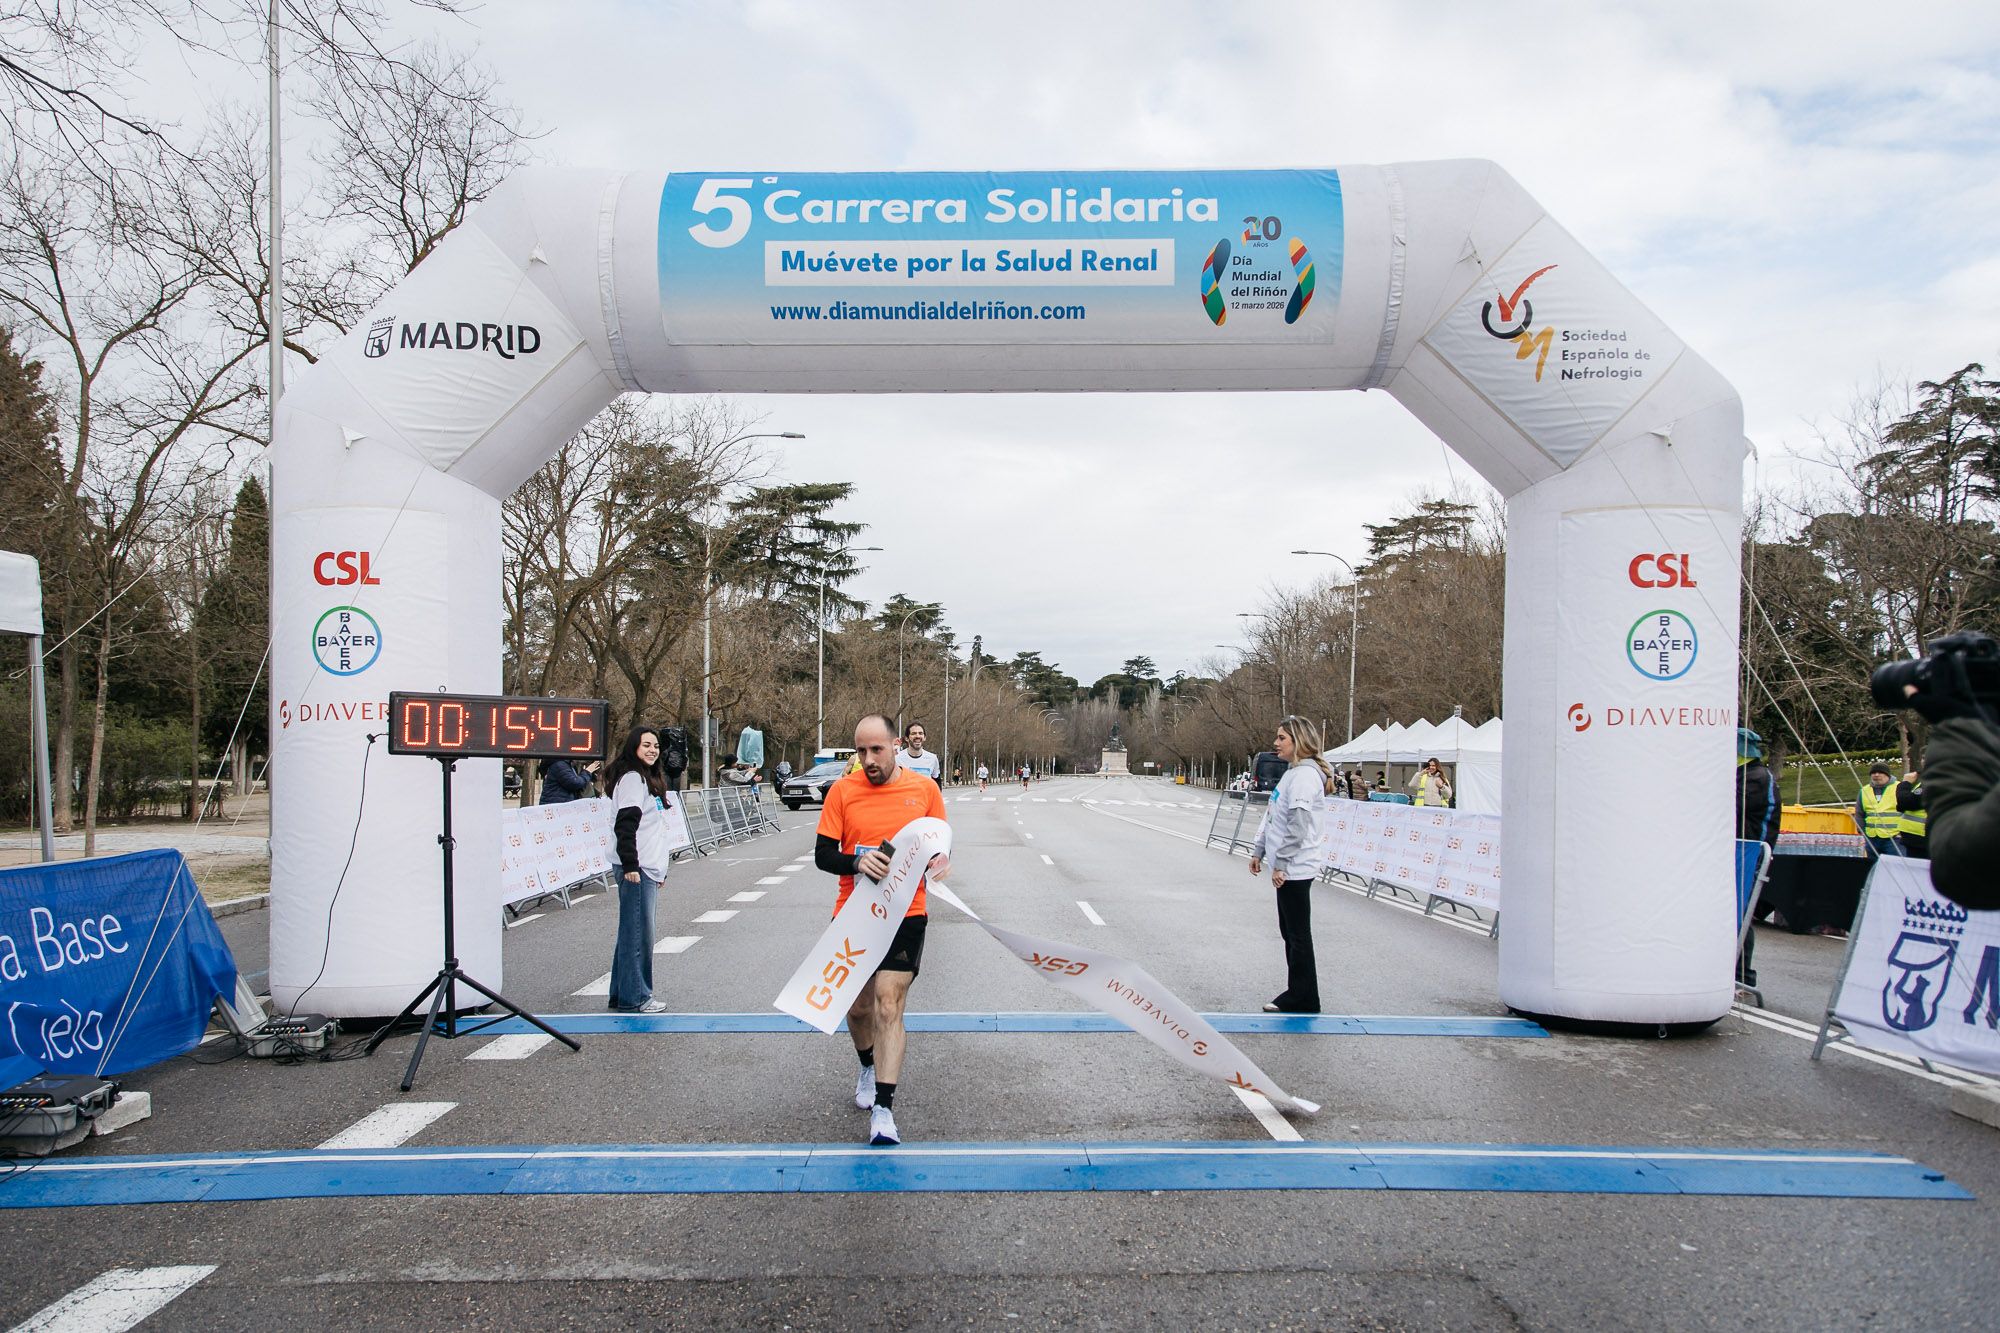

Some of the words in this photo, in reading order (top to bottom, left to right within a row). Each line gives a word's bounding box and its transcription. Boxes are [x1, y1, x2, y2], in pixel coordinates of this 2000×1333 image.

[763, 189, 967, 223] Carrera
[984, 187, 1219, 223] Solidaria
[1242, 216, 1282, 247] 20
[781, 250, 898, 272] Muévete
[907, 256, 952, 278] por
[961, 249, 985, 272] la
[995, 249, 1072, 272] Salud
[1081, 249, 1158, 272] Renal
[1232, 255, 1253, 266] Día
[1231, 270, 1282, 281] Mundial
[1230, 286, 1250, 297] del
[1252, 286, 1288, 297] Riñón
[1231, 301, 1240, 310] 12
[1241, 302, 1265, 310] marzo
[1266, 301, 1285, 310] 2026
[770, 300, 1086, 320] www.diamundialdelriñon.com
[400, 322, 541, 359] MADRID
[1562, 330, 1627, 342] Sociedad
[1562, 348, 1629, 363] Española
[1634, 349, 1651, 360] de
[313, 551, 381, 587] CSL
[1628, 553, 1698, 588] CSL
[318, 636, 376, 647] BAYER
[339, 612, 351, 670] BAYER
[1633, 639, 1692, 651] BAYER
[1658, 615, 1671, 675] BAYER
[300, 702, 389, 721] DIAVER
[1607, 707, 1731, 726] DIAVERUM
[405, 702, 593, 751] 00:15:45
[0, 935, 27, 983] a
[30, 907, 129, 972] Base
[806, 937, 866, 1011] GSK
[1023, 952, 1089, 976] GSK
[1107, 979, 1189, 1040] DIAVERUM
[8, 998, 103, 1061] Cielo
